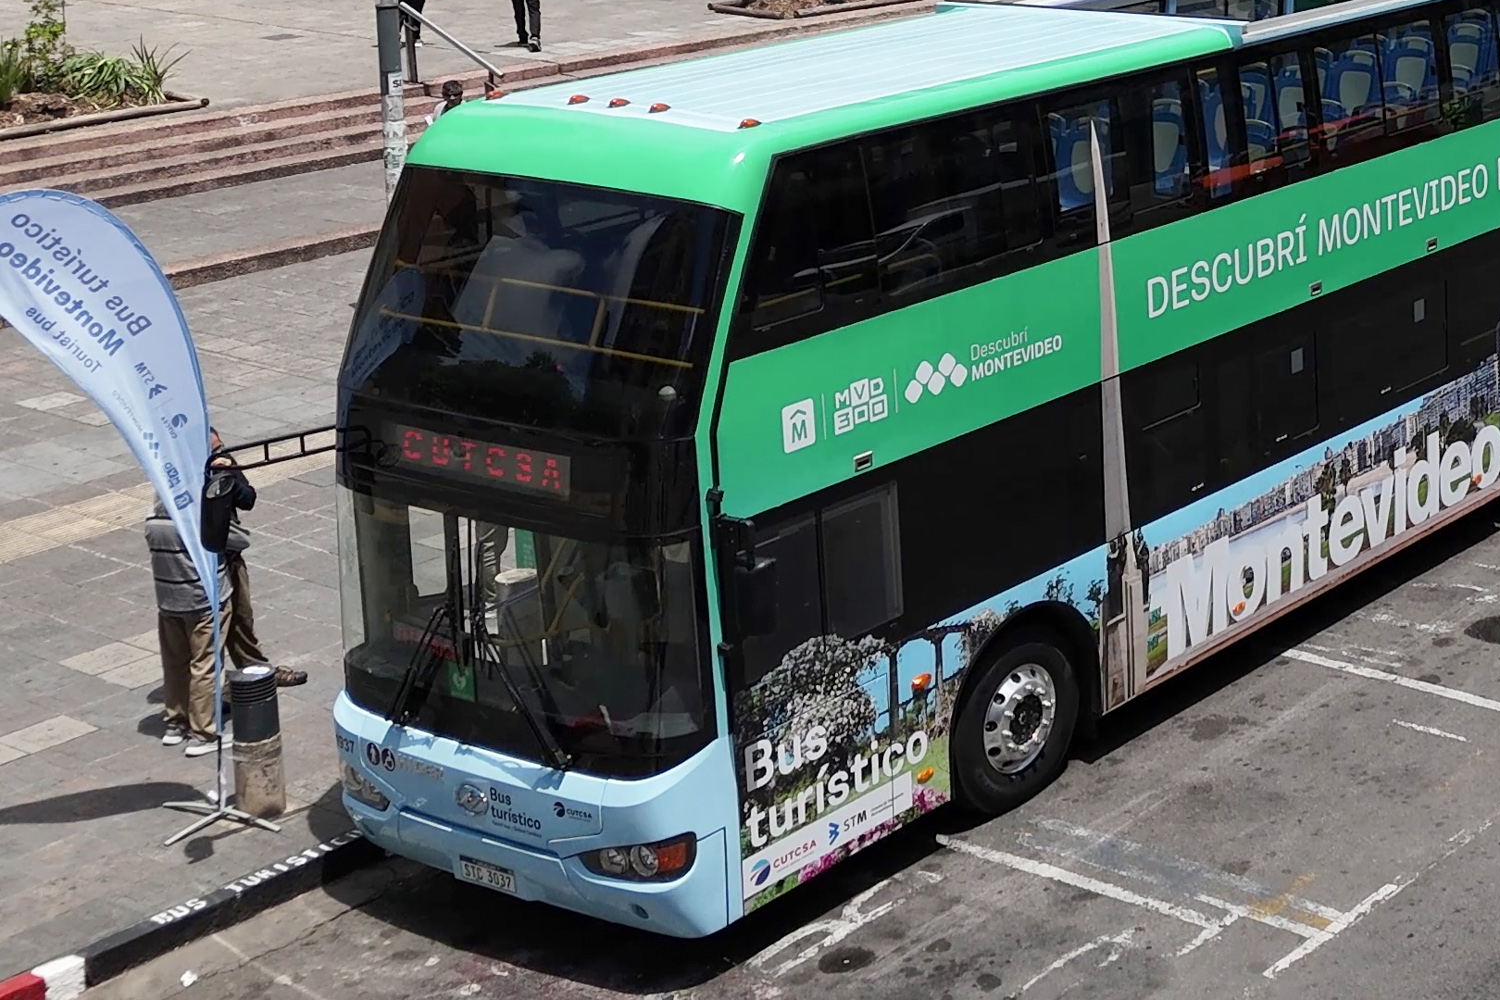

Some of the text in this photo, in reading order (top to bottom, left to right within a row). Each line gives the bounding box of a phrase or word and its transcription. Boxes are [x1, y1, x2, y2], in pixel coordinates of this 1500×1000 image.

[1146, 214, 1308, 319] DESCUBRÍ
[1317, 163, 1489, 256] MONTEVIDEO
[970, 325, 1029, 362] Descubrí
[971, 334, 1063, 382] MONTEVIDEO
[835, 377, 884, 409] MVD
[744, 725, 828, 793] Bus
[490, 787, 512, 806] Bus
[745, 730, 928, 848] turístico
[490, 805, 542, 831] turístico
[567, 807, 593, 819] CUTCSA
[843, 810, 868, 833] STM
[772, 839, 817, 869] CUTCSA
[464, 863, 484, 884] STC
[487, 871, 511, 889] 3037
